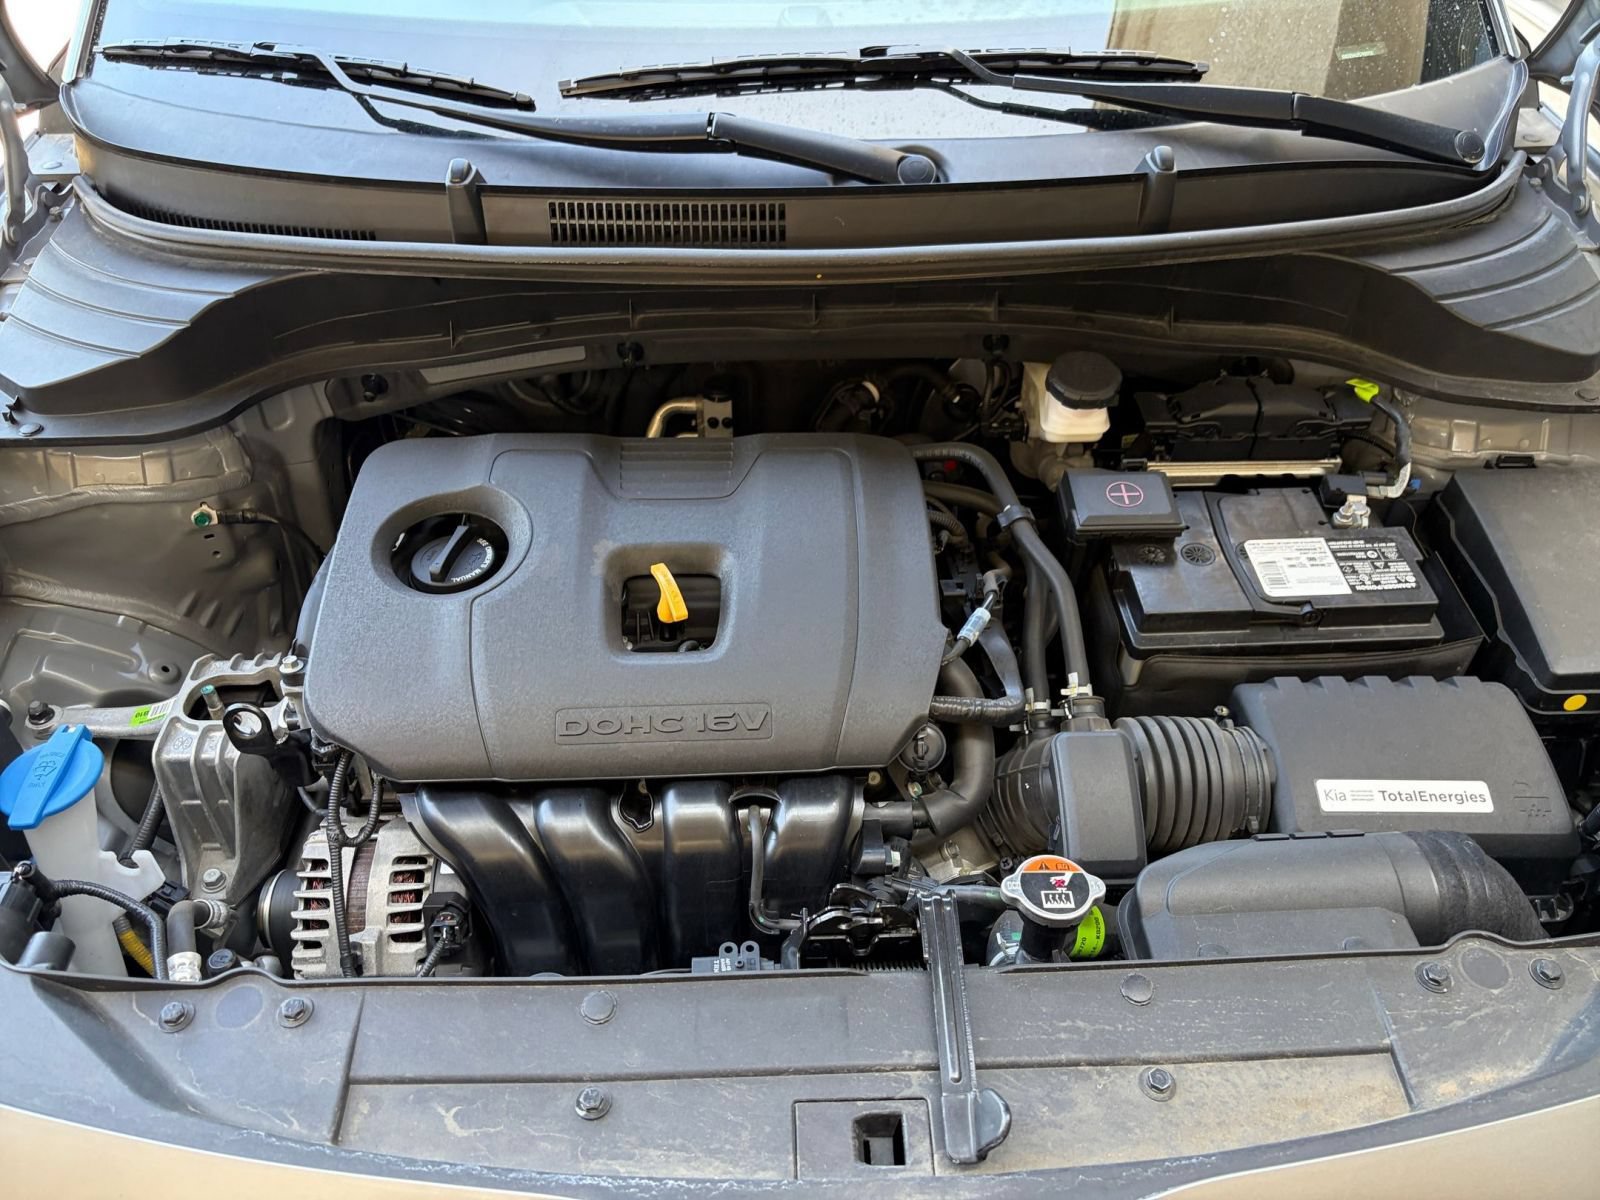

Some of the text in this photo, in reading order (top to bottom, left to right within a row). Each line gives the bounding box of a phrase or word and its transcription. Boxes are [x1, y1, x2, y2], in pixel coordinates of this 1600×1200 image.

[451, 569, 481, 582] MANUAL
[558, 711, 769, 737] DOHC 16V
[1323, 788, 1487, 804] Kia TotalEnergies
